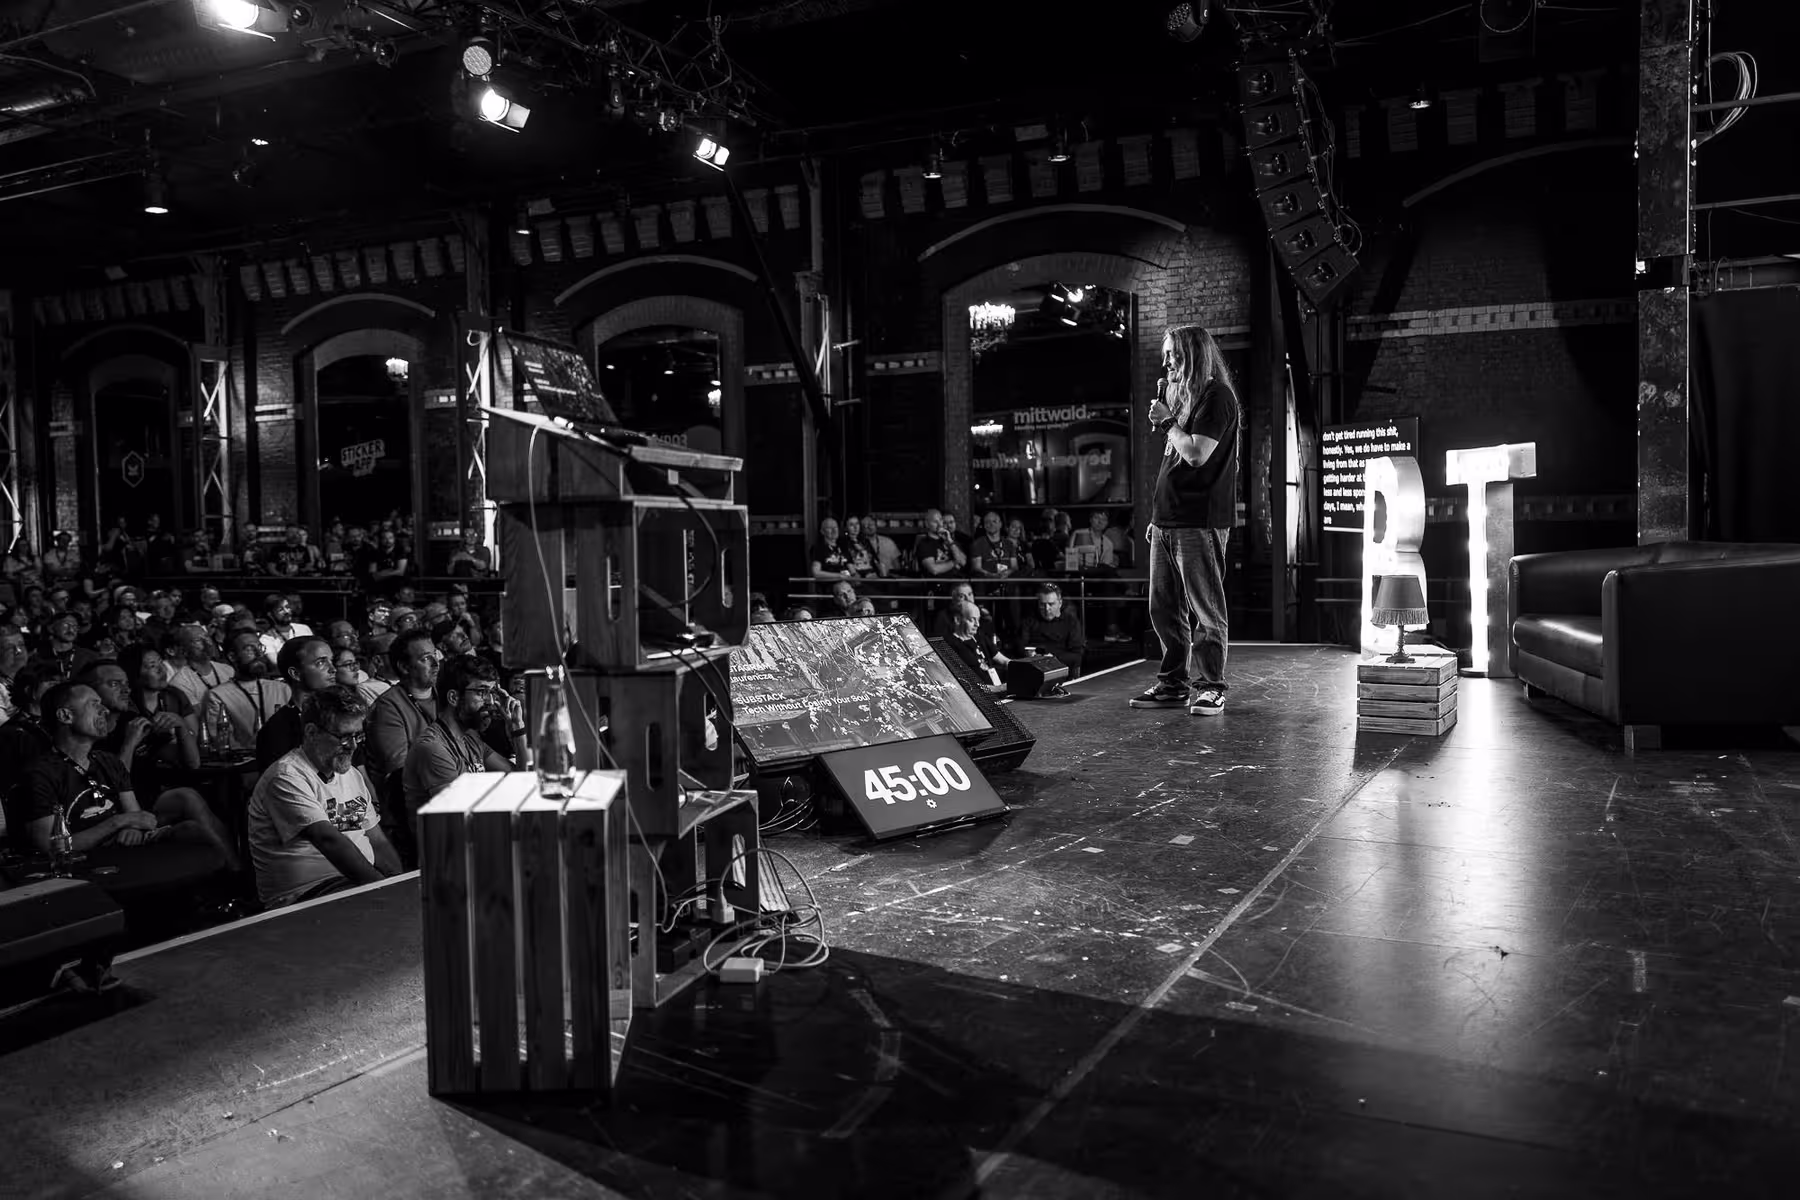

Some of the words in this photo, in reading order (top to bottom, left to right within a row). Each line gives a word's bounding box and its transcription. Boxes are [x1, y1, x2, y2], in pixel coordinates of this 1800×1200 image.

[1323, 431, 1335, 441] don't
[1335, 431, 1343, 442] get
[1344, 429, 1355, 439] tired
[1356, 429, 1375, 439] running
[1376, 427, 1386, 437] this
[342, 440, 382, 462] STICKER
[1363, 443, 1370, 453] do
[1371, 443, 1383, 452] have
[1384, 443, 1390, 451] to
[1391, 441, 1406, 451] make
[1407, 442, 1411, 450] a
[1323, 459, 1335, 470] living
[1336, 459, 1347, 468] from
[1348, 459, 1358, 468] that
[1323, 474, 1339, 484] getting
[1340, 473, 1355, 482] harder
[1356, 473, 1362, 482] at
[1324, 487, 1332, 496] less
[1333, 487, 1342, 496] and
[1343, 487, 1352, 496] less
[1324, 501, 1336, 512] days,
[1336, 501, 1339, 511] I
[1340, 503, 1355, 513] mean,
[1324, 516, 1332, 524] are
[735, 692, 787, 705] SUBSTACK
[742, 705, 767, 715] Tech
[765, 702, 803, 712] Without
[802, 698, 832, 708] Losing
[830, 696, 851, 705] Your
[851, 693, 870, 702] Soul
[864, 756, 971, 805] 45:00
